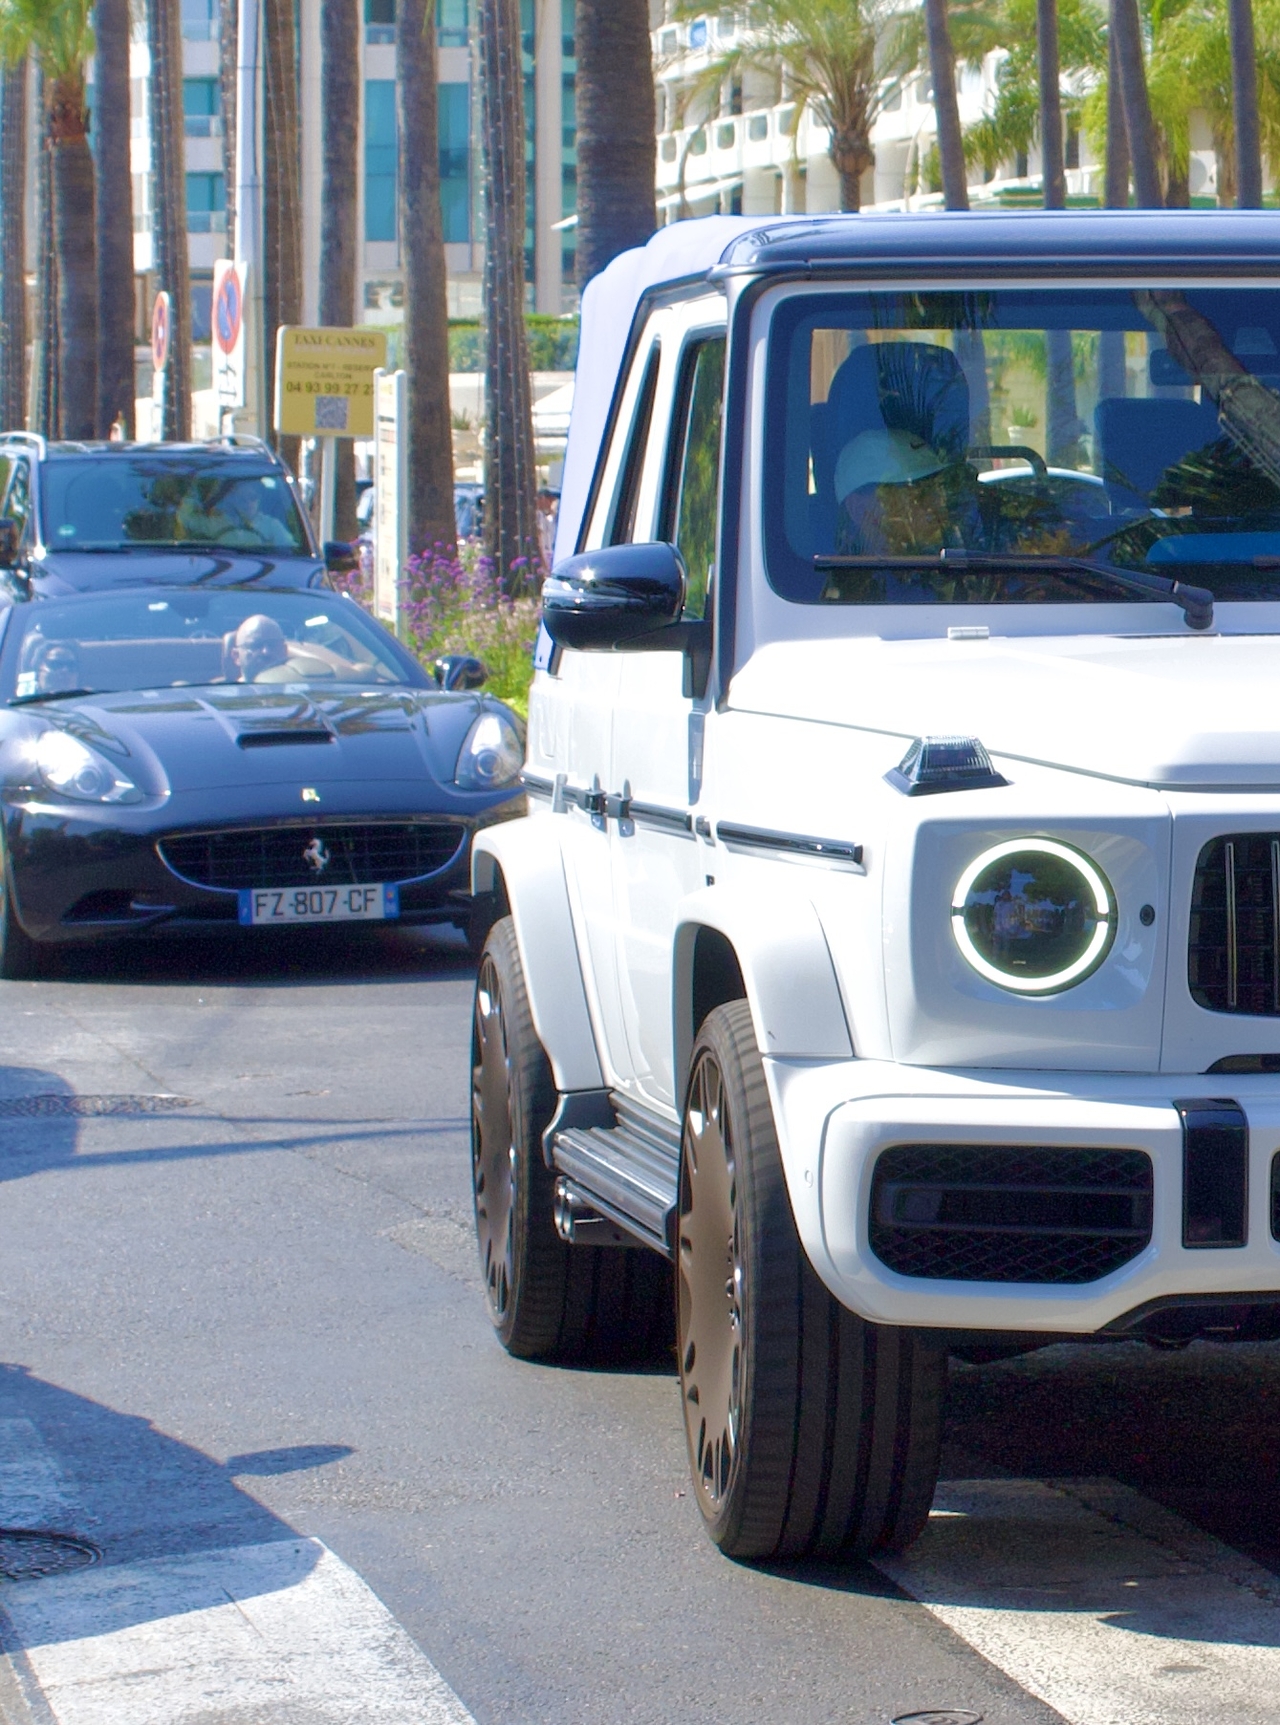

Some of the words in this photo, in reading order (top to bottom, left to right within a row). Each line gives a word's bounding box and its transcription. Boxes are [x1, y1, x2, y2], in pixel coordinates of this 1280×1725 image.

[294, 333, 323, 345] TAXI
[325, 334, 376, 348] CANNES
[286, 381, 302, 394] 04
[305, 381, 320, 395] 93
[324, 382, 340, 395] 99
[344, 383, 359, 396] 27
[363, 384, 375, 396] 2
